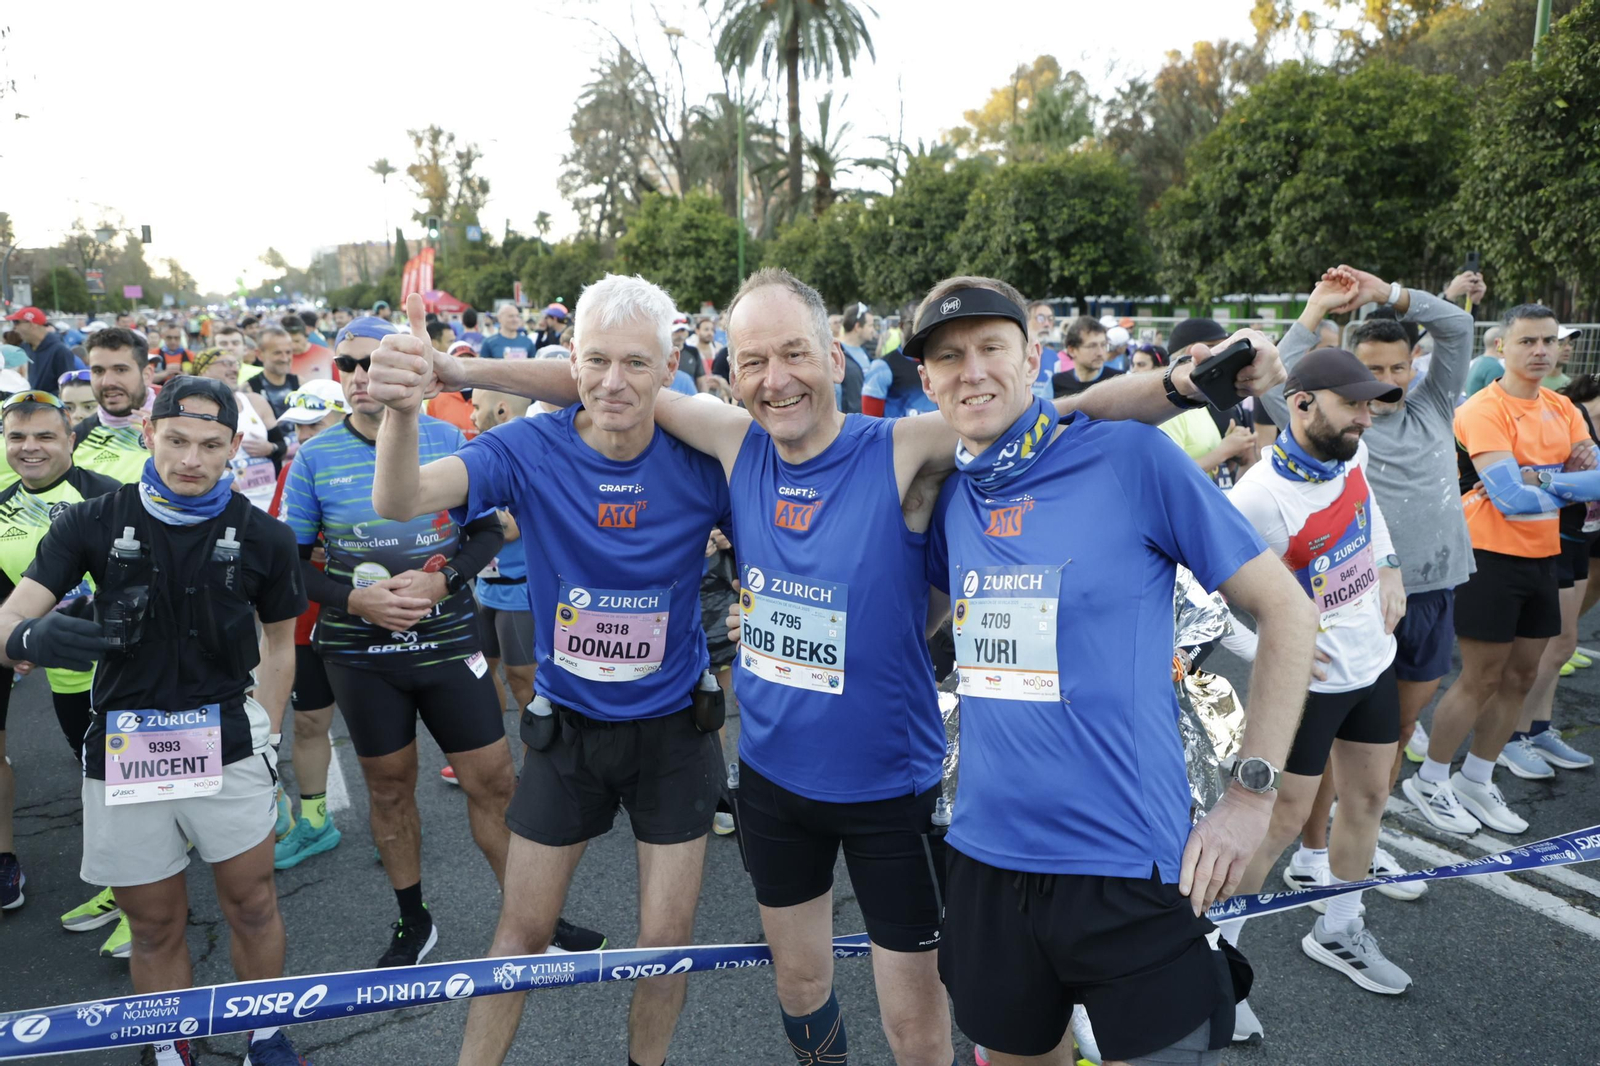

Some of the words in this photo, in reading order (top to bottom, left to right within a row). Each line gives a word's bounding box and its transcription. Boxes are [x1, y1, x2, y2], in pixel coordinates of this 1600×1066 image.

[943, 299, 960, 314] Buff
[599, 484, 634, 492] CRAFT
[779, 487, 808, 497] CRAFT
[600, 506, 634, 526] ATC
[777, 504, 812, 526] ATC
[987, 508, 1020, 535] ATC
[1333, 534, 1367, 562] ZURICH
[1340, 564, 1358, 582] 8461
[771, 578, 832, 603] ZURICH
[983, 574, 1043, 590] ZURICH
[1323, 568, 1375, 608] RICARDO
[598, 595, 659, 609] ZURICH
[596, 622, 629, 635] 9318
[770, 611, 802, 630] 4795
[981, 613, 1011, 629] 4709
[568, 635, 651, 660] DONALD
[743, 623, 775, 653] ROB
[782, 635, 837, 665] BEKS
[974, 638, 1017, 664] YURI
[146, 712, 207, 727] ZURICH
[148, 740, 181, 754] 9393
[120, 756, 209, 780] VINCENT
[530, 962, 575, 974] SEVILLA
[530, 973, 575, 986] MARATÓN
[357, 981, 442, 1005] ZURICH
[124, 996, 180, 1009] SEVILLA
[223, 991, 295, 1019] asics
[123, 1006, 179, 1021] MARATÓN
[121, 1022, 178, 1038] ZURICH
